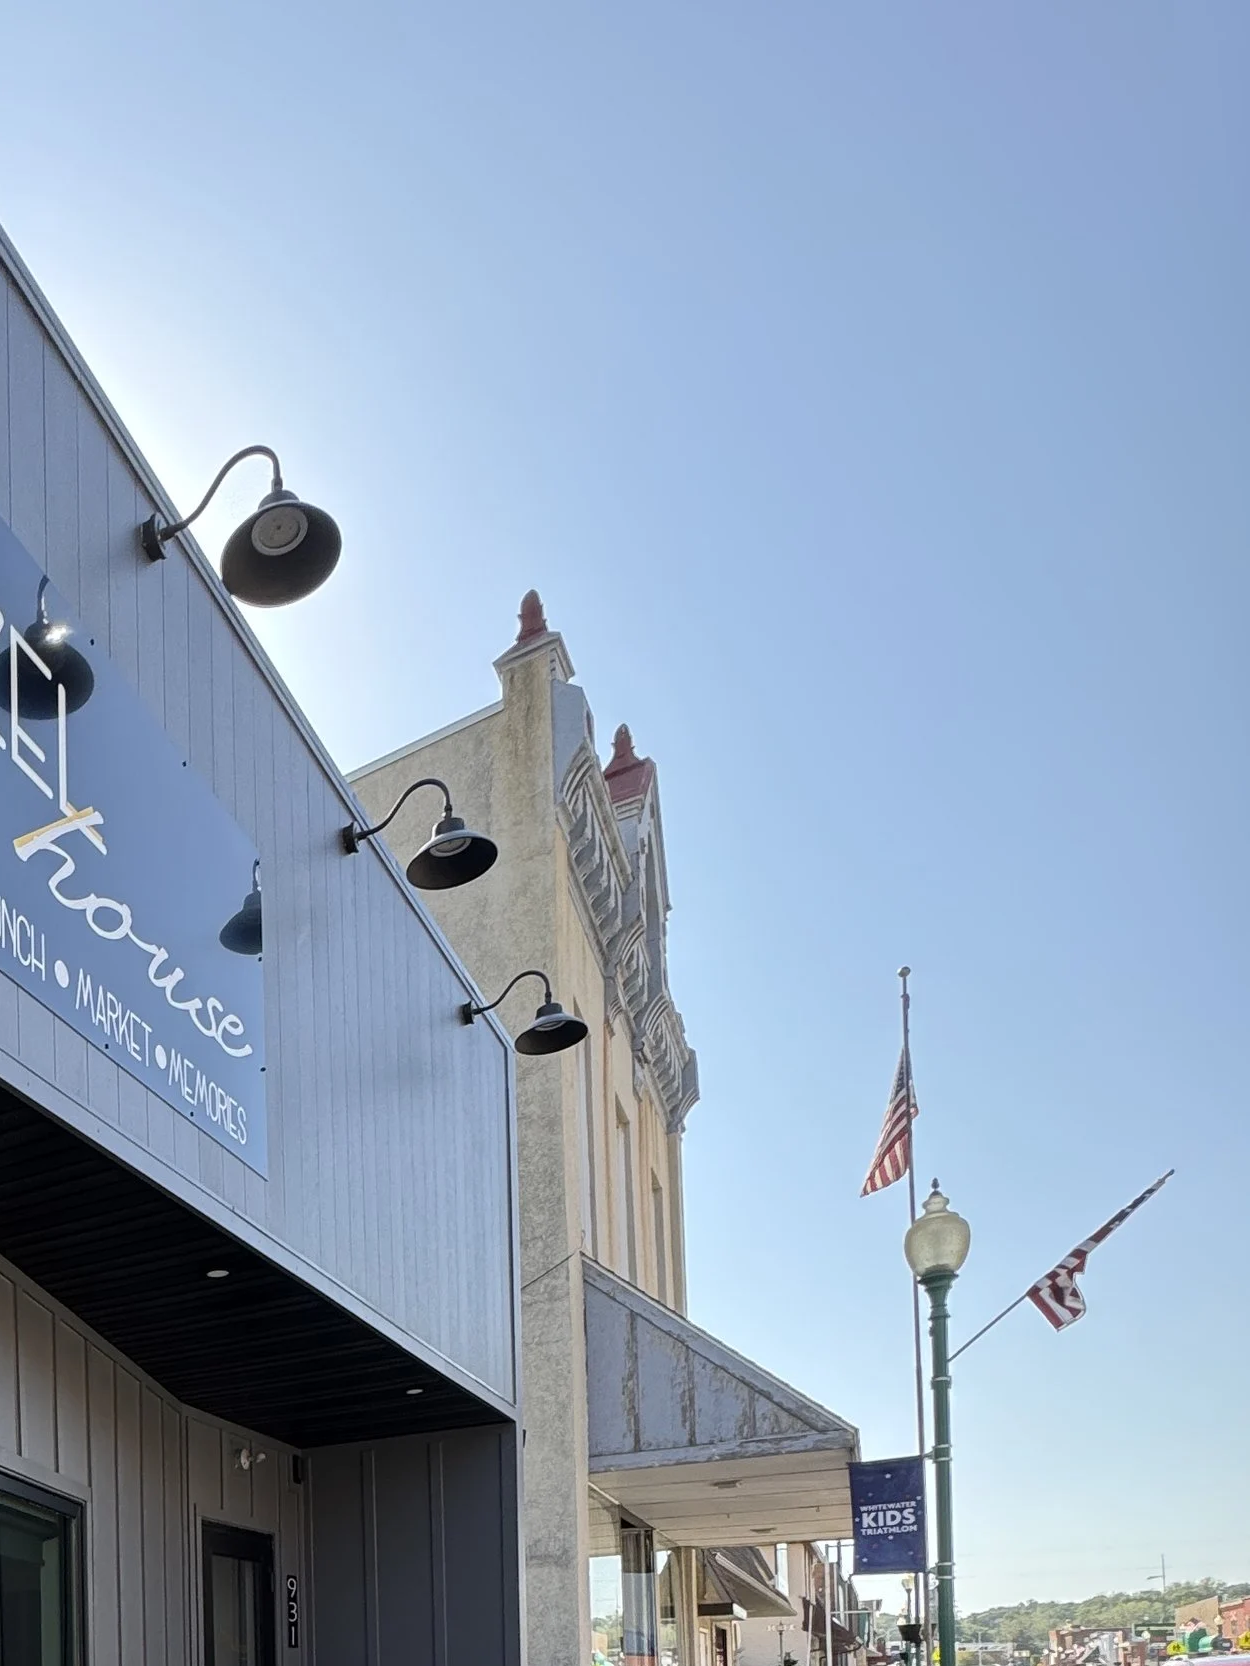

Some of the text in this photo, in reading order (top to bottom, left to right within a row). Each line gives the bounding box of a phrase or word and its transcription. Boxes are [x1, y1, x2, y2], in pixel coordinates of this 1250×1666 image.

[14, 810, 253, 1058] house
[75, 968, 152, 1068] MARKET
[168, 1048, 247, 1145] MEMORIES
[859, 1501, 917, 1512] WHITEWATER
[861, 1508, 916, 1528] KIDS
[860, 1525, 918, 1535] TRIATHLON
[287, 1577, 298, 1647] 931
